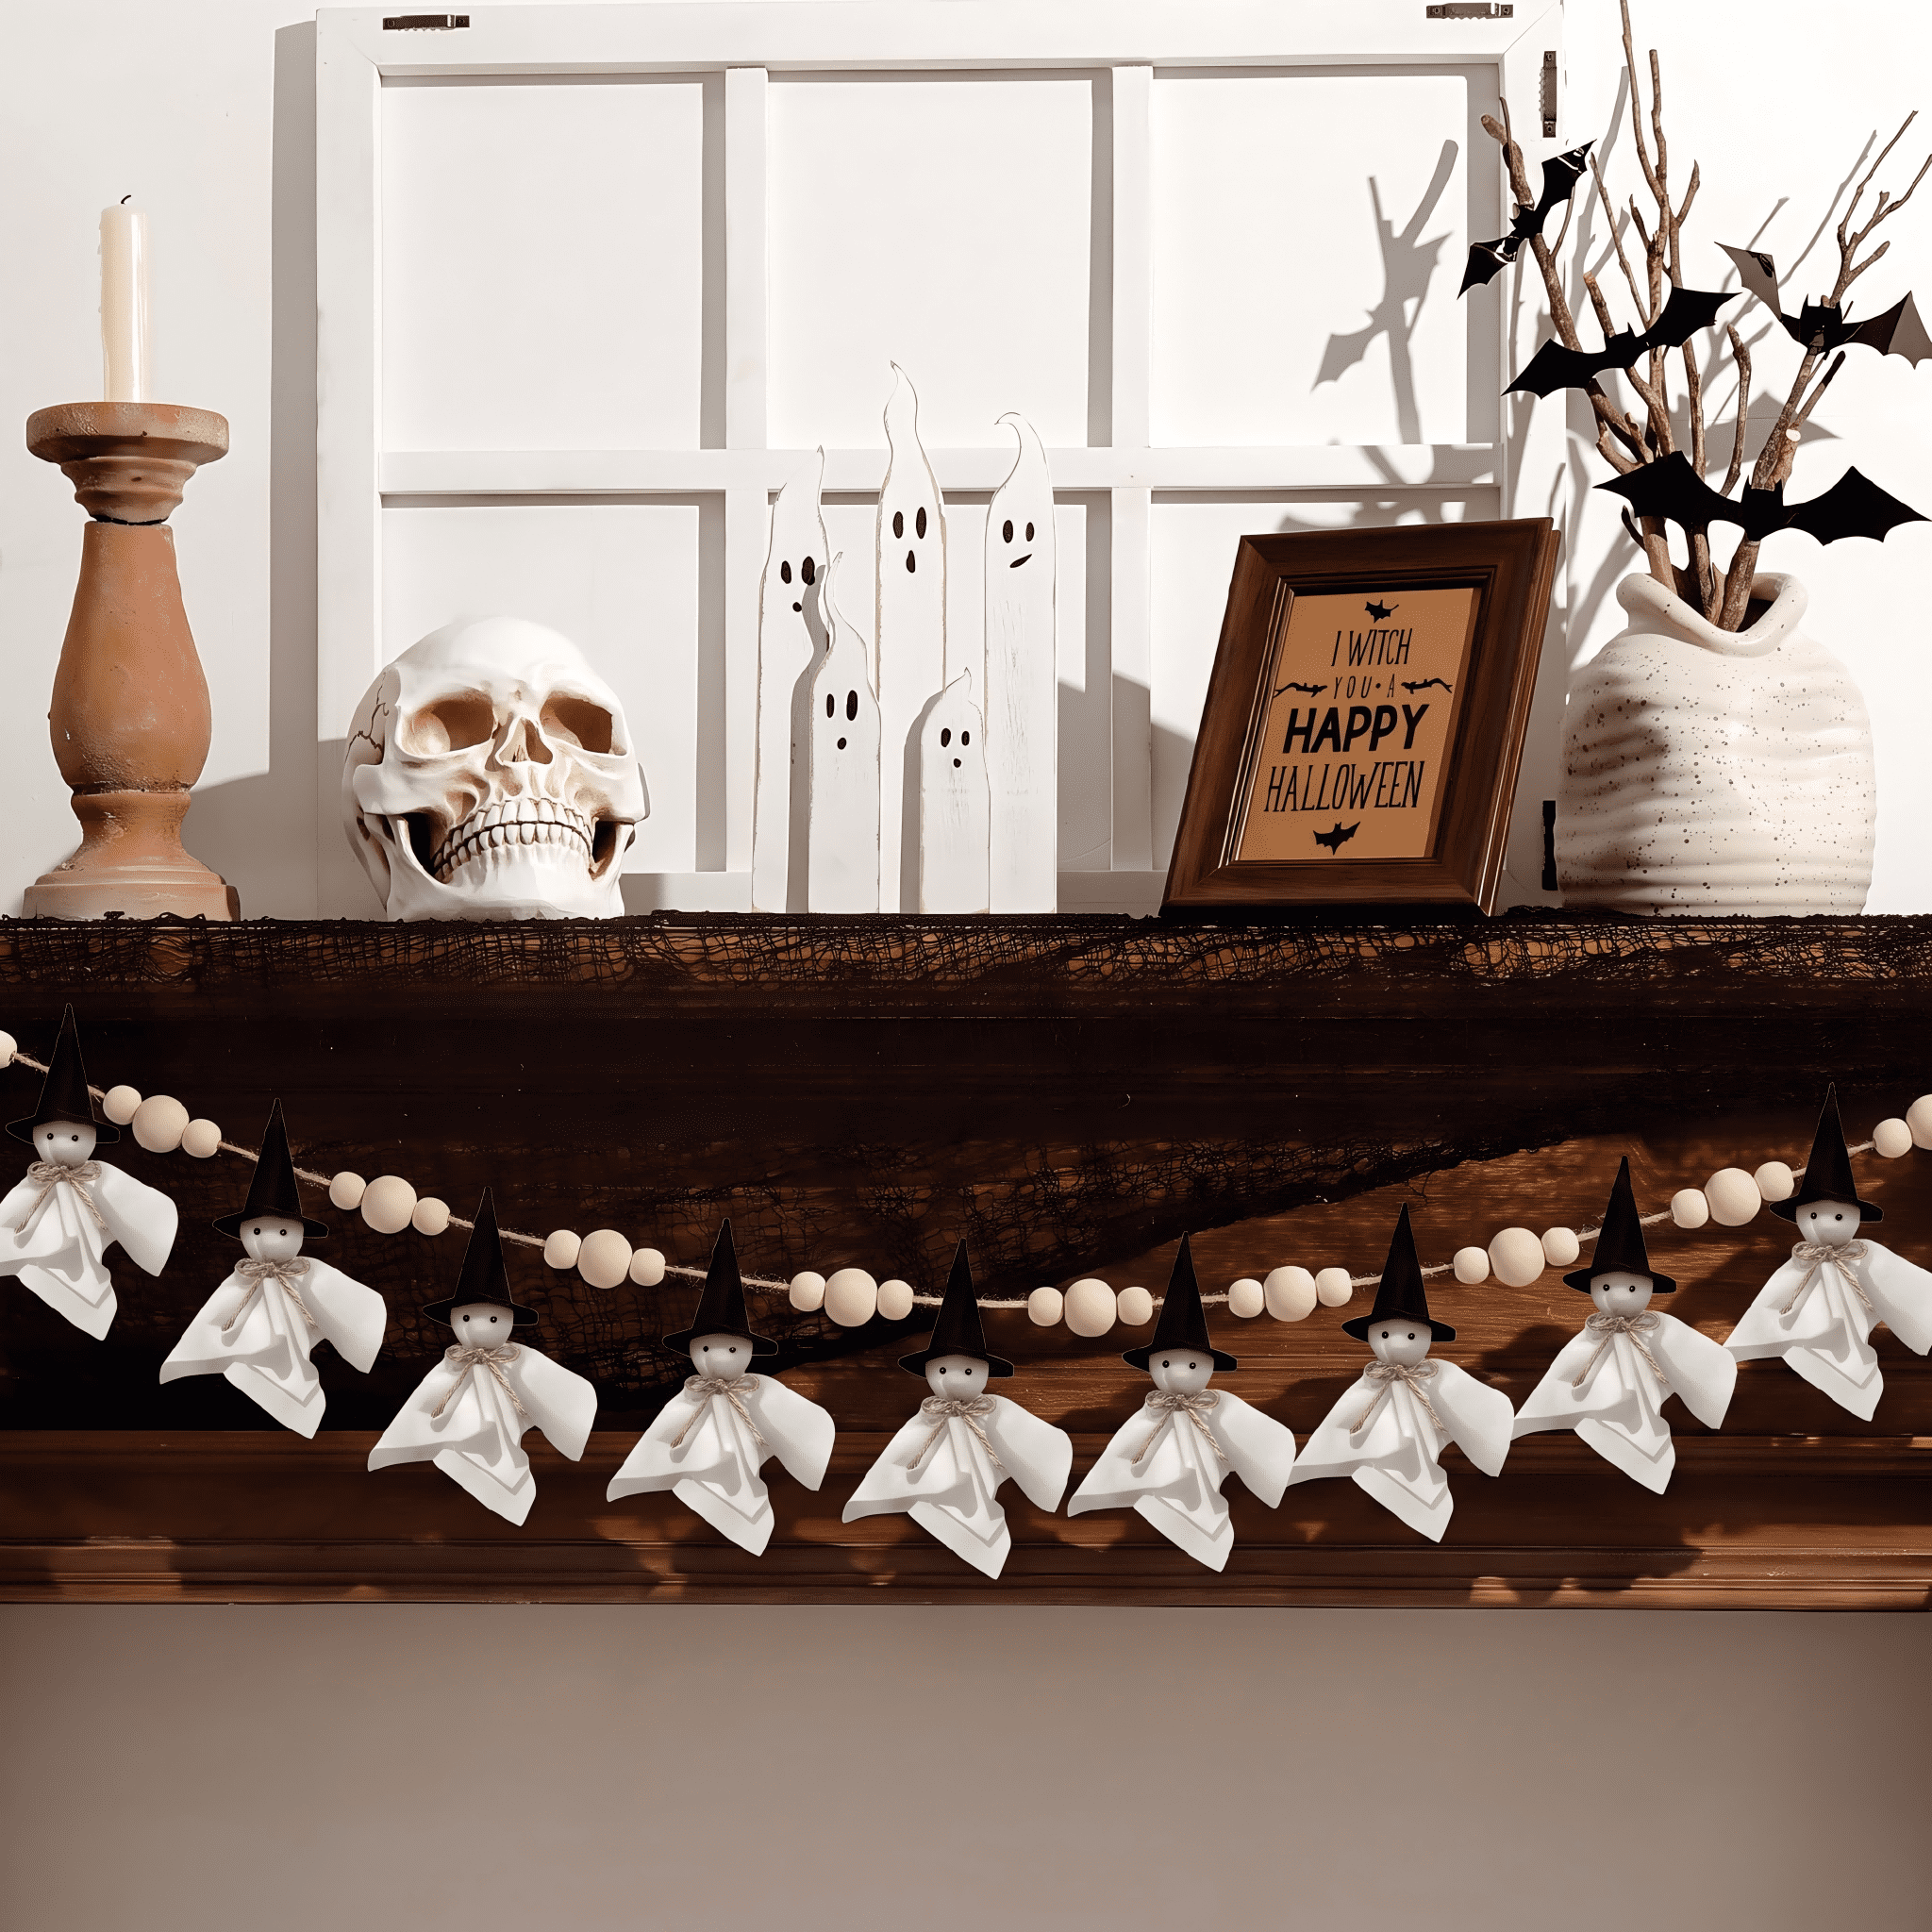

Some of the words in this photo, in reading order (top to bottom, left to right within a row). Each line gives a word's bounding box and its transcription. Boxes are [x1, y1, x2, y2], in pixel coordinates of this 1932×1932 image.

[1331, 630, 1341, 666] I
[1348, 628, 1413, 666] WITCH
[1282, 704, 1430, 754] HAPPY
[1263, 760, 1425, 812] HALLOWEEN
